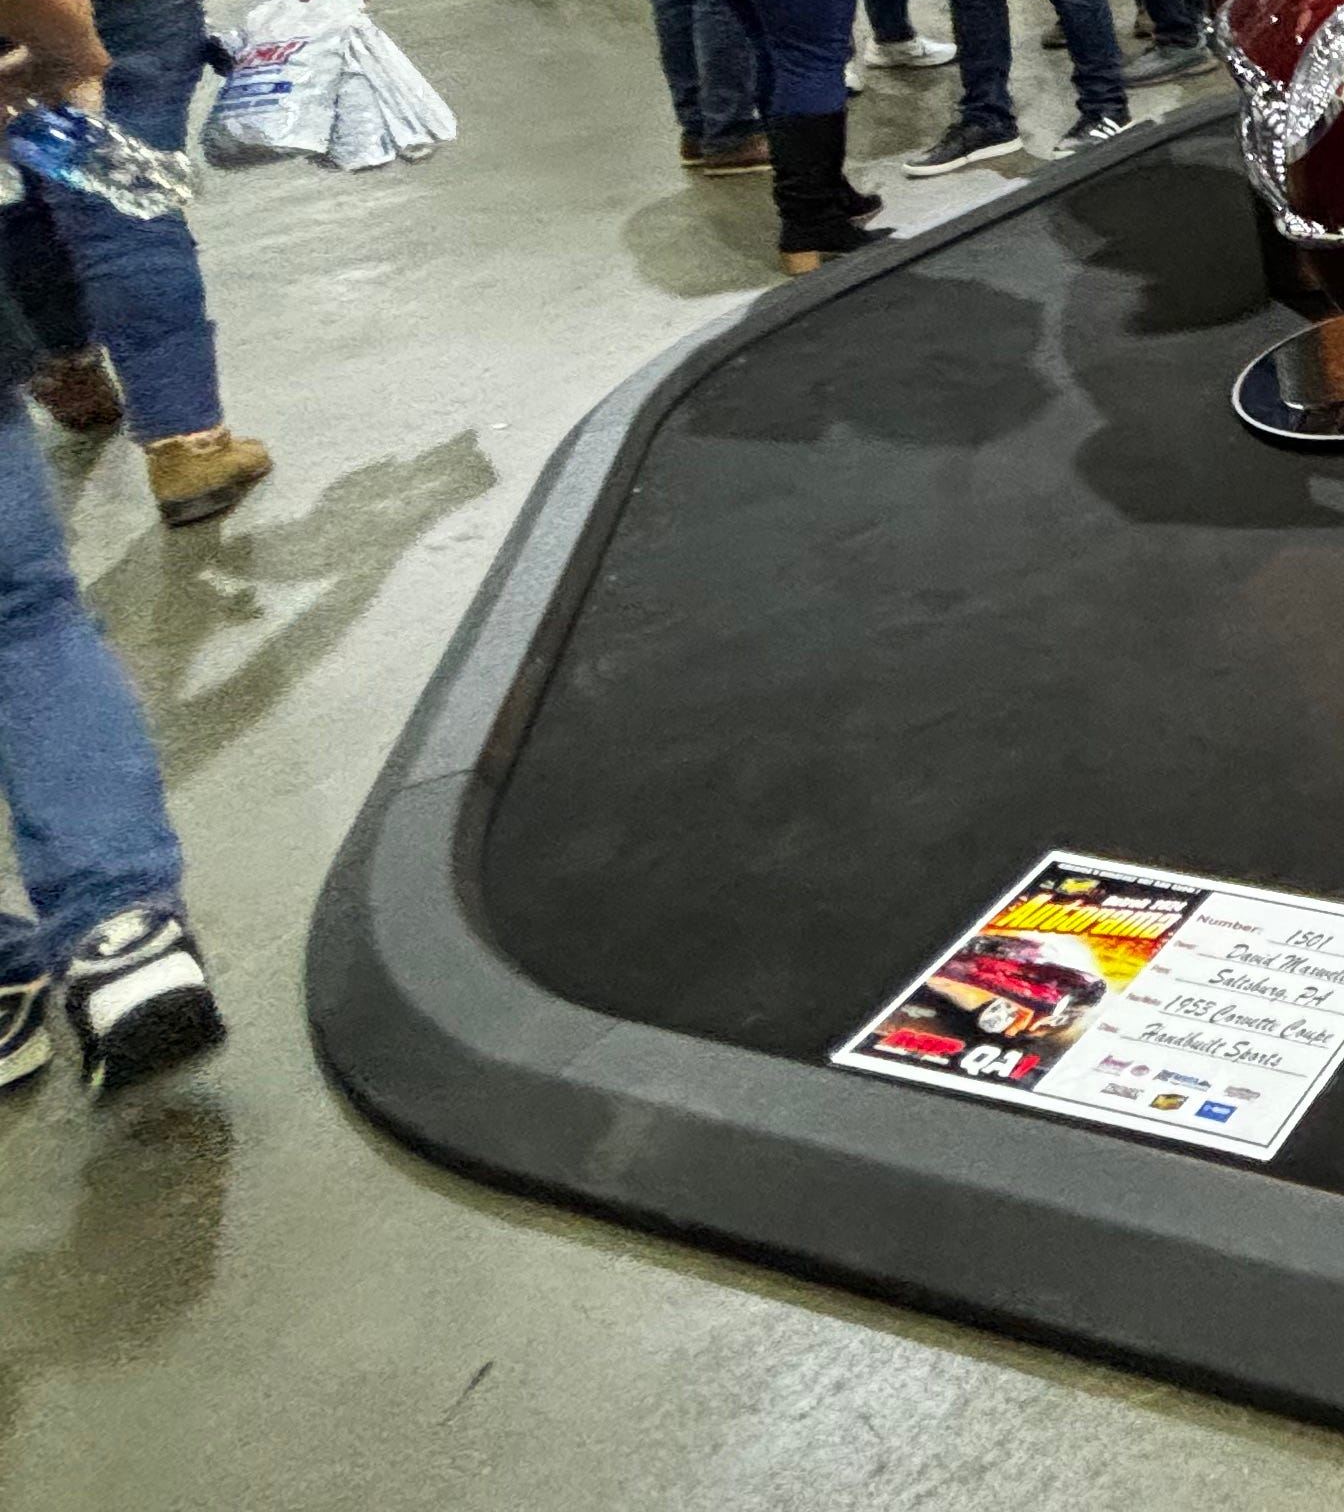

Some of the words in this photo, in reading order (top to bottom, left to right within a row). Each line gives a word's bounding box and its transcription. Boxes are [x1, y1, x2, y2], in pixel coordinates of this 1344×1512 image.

[996, 894, 1182, 938] Autorama
[1225, 943, 1283, 968] David
[1285, 930, 1335, 950] 1501
[1297, 986, 1335, 1007] PA
[1163, 994, 1217, 1017] 1953
[1278, 1019, 1337, 1046] Coupe
[960, 1044, 1041, 1080] QA1
[1139, 1022, 1227, 1055] Handbuilt
[1223, 1041, 1285, 1068] Sports
